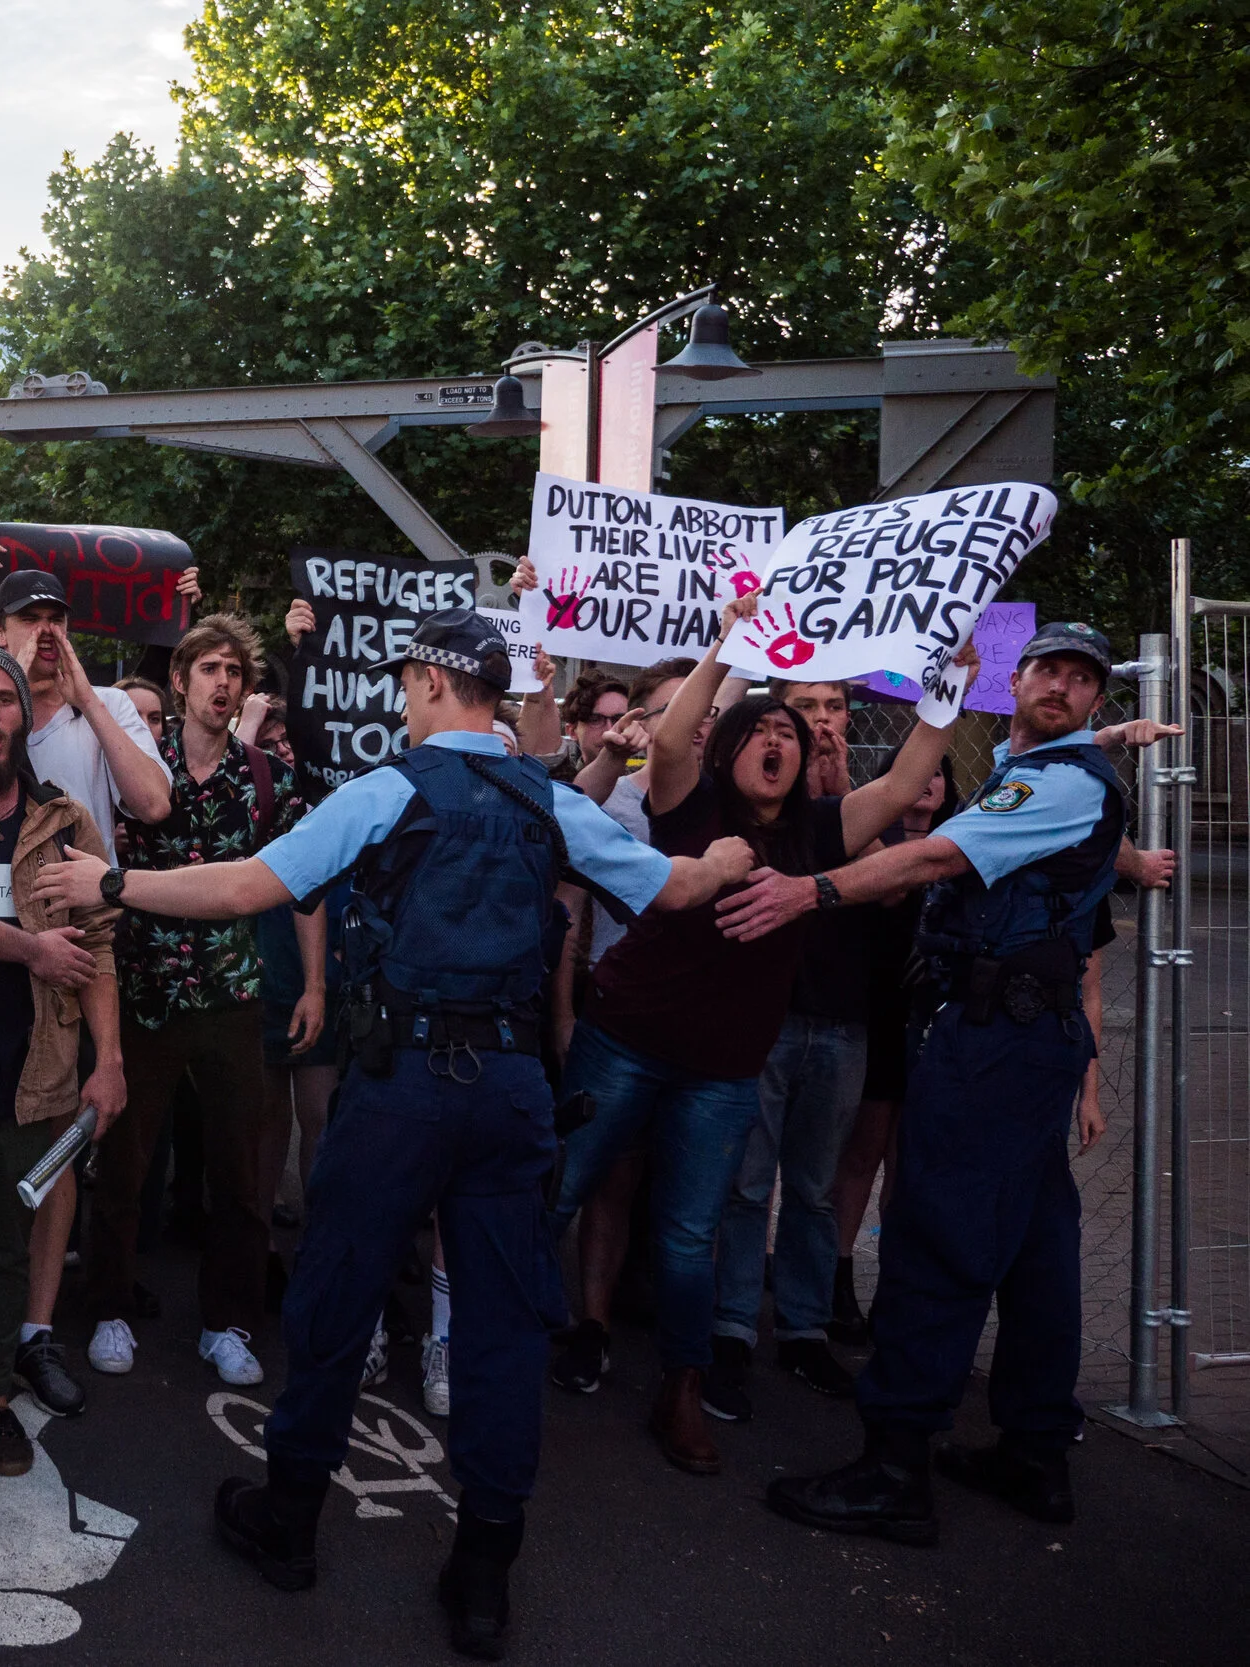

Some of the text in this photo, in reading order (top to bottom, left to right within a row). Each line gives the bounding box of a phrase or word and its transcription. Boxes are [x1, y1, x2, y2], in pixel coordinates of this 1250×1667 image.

[440, 396, 464, 404] EXCEED
[466, 395, 475, 404] 7
[445, 387, 462, 395] LOAD
[547, 484, 777, 544] DUTTON, ABBOTT
[941, 488, 1040, 537] KILL
[569, 525, 737, 569] THEIR LIVES
[306, 556, 474, 613] REFUGEES
[590, 561, 716, 601] ARE IN
[763, 555, 1004, 605] FOR POLIT
[323, 614, 417, 662] ARE
[485, 616, 521, 634] ING
[543, 587, 722, 648] YOUR HAN
[508, 643, 538, 660] ERE
[302, 665, 408, 713] HUM
